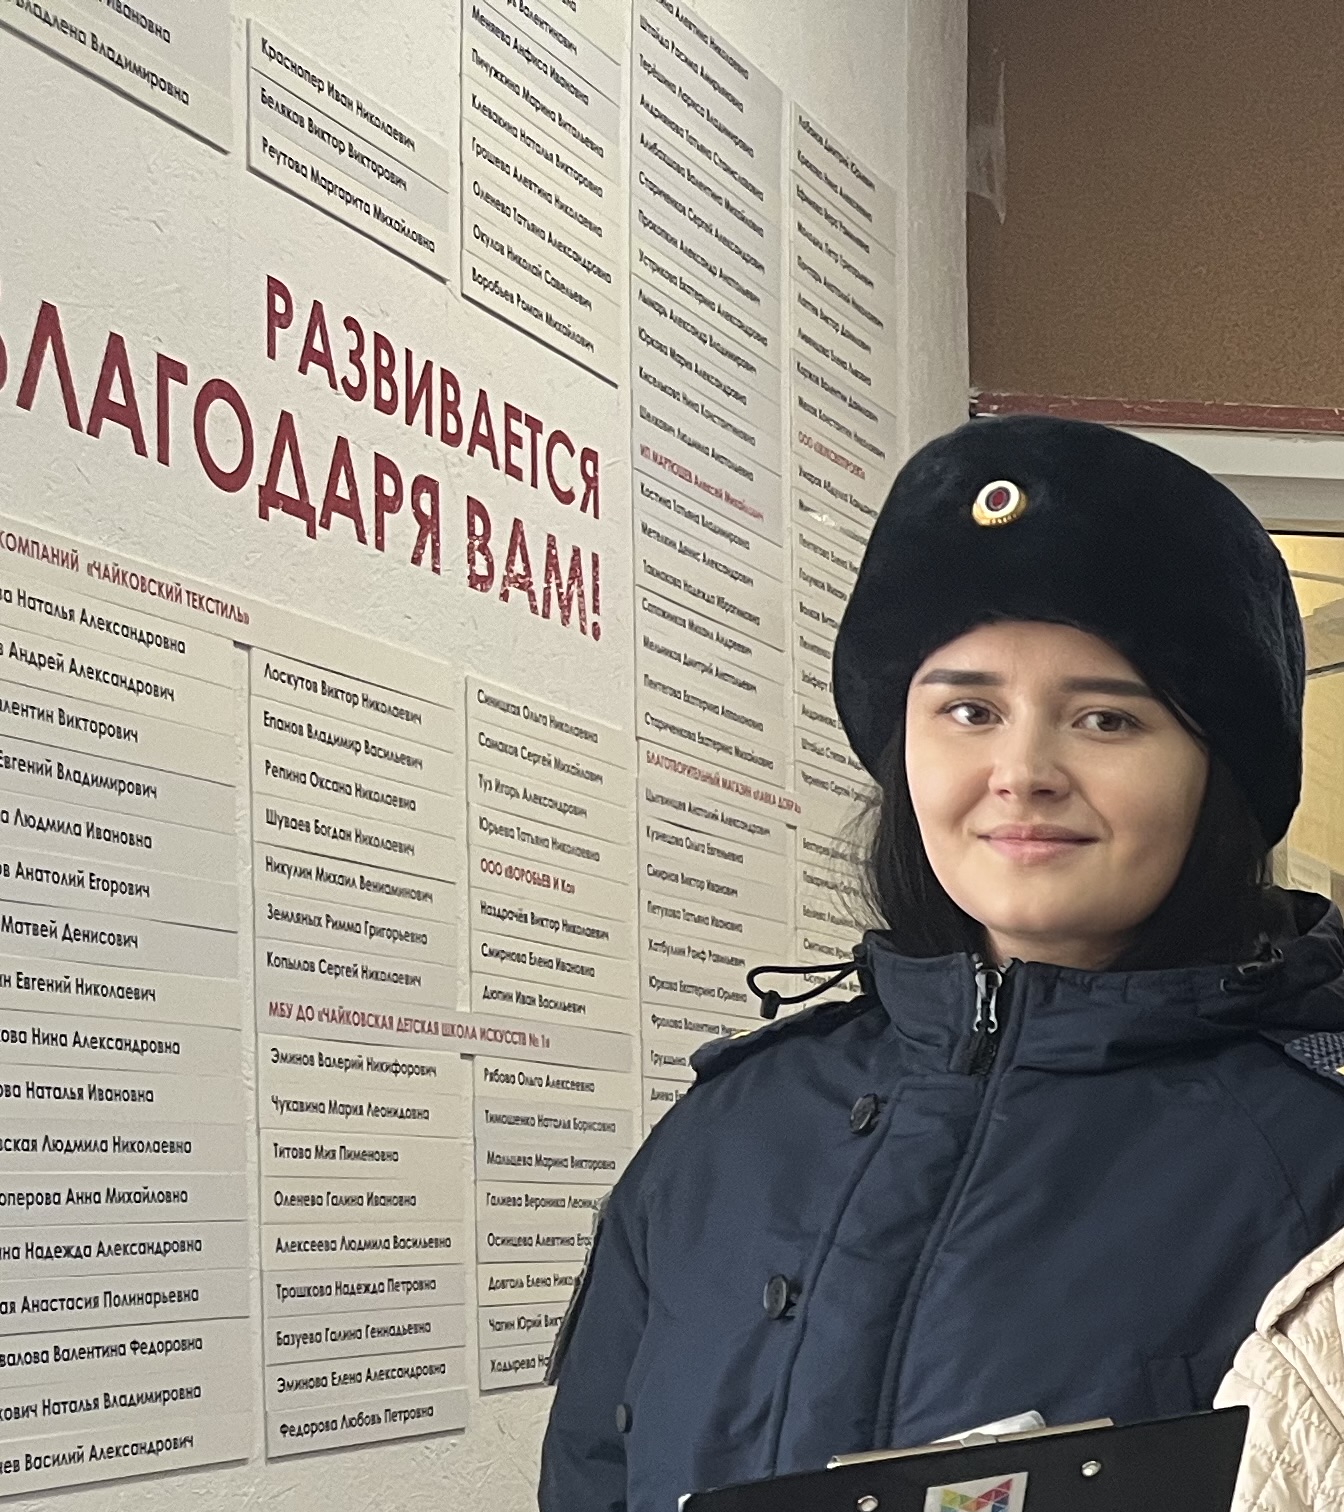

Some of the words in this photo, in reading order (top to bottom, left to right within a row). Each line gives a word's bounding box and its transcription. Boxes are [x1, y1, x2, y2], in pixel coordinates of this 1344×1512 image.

[92, 32, 190, 106] Владимировна
[327, 80, 354, 112] Иван
[356, 99, 416, 152] Николаевич
[260, 86, 305, 129] Беляков
[307, 116, 346, 156] Виктор
[347, 141, 407, 192] Викторович
[261, 135, 308, 179] Реутова
[310, 166, 371, 216] Маргарита
[372, 203, 435, 254] Михайловна
[266, 274, 600, 519] РАЗВИВАЕТСЯ
[0, 299, 442, 575] ЛАГОДАРЯ
[466, 495, 602, 641] ВАМ!
[17, 588, 75, 622] Наталья
[79, 607, 186, 654] Александровна
[8, 641, 65, 673] Андрей
[68, 657, 175, 702] Александрович
[320, 679, 360, 708] Виктор
[361, 692, 422, 726] Николаевич
[57, 707, 138, 744] Викторович
[306, 722, 362, 756] Владимир
[363, 739, 423, 770] Васильевич
[56, 761, 158, 799] Владимирович
[264, 759, 307, 785] Репина
[309, 771, 353, 796] Оксана
[354, 782, 417, 812] Николаевна
[13, 807, 82, 837] Людмила
[85, 821, 152, 849] Ивановна
[314, 818, 352, 842] Богдан
[354, 828, 415, 857] Николаевич
[14, 861, 86, 889] Анатолий
[88, 872, 150, 898] Егорович
[265, 855, 313, 881] Никулин
[314, 866, 358, 889] Михаил
[359, 874, 434, 904] Вениаминович
[0, 914, 58, 940] Матвей
[61, 922, 139, 949] Денисович
[325, 913, 362, 934] Римма
[364, 920, 428, 946] Григорьевна
[16, 971, 72, 994] Евгений
[75, 977, 156, 1002] Николаевич
[266, 951, 316, 973] Копылов
[318, 958, 359, 979] Сергей
[360, 964, 422, 987] Николаевич
[268, 1001, 294, 1019] МБУ
[295, 1004, 315, 1023] ДО
[395, 1016, 440, 1036] ДЕТСКАЯ
[441, 1022, 478, 1041] ШКОЛА
[479, 1027, 527, 1046] ИСКУССТВ
[31, 1027, 68, 1047] Нина
[71, 1030, 181, 1057] Александровна
[317, 1051, 364, 1073] Валерий
[366, 1056, 437, 1078] Никифорович
[25, 1081, 84, 1101] Наталья
[87, 1083, 154, 1103] Ивановна
[327, 1099, 364, 1120] Мария
[366, 1101, 430, 1121] Леонидовна
[41, 1134, 109, 1155] Людмила
[112, 1135, 192, 1154] Николаевна
[272, 1142, 312, 1160] Титова
[338, 1145, 399, 1163] Пименовна
[65, 1187, 102, 1205] Анна
[105, 1185, 188, 1204] Михайловна
[273, 1190, 324, 1207] Оленева
[326, 1191, 364, 1207] Галина
[366, 1191, 417, 1207] Ивановна
[25, 1241, 92, 1261] Надежда
[95, 1239, 202, 1258] Александровна
[275, 1237, 337, 1254] Алексеева
[339, 1235, 391, 1252] Людмила
[392, 1234, 452, 1250] Васильевна
[334, 1280, 385, 1296] Надежда
[387, 1277, 437, 1296] Петровна
[20, 1295, 100, 1314] Анастасия
[324, 1327, 363, 1343] Галина
[365, 1321, 432, 1339] Геннадьевна
[53, 1343, 127, 1363] Валентина
[129, 1337, 203, 1357] Федоровна
[330, 1371, 363, 1387] Елена
[365, 1363, 446, 1383] Александровна
[41, 1397, 100, 1417] Наталья
[103, 1385, 202, 1410] Владимировна
[279, 1419, 338, 1438] Федорова
[340, 1411, 382, 1430] Любовь
[384, 1405, 434, 1425] Петровна
[24, 1445, 85, 1472] Василий
[88, 1435, 194, 1462] Александрович
